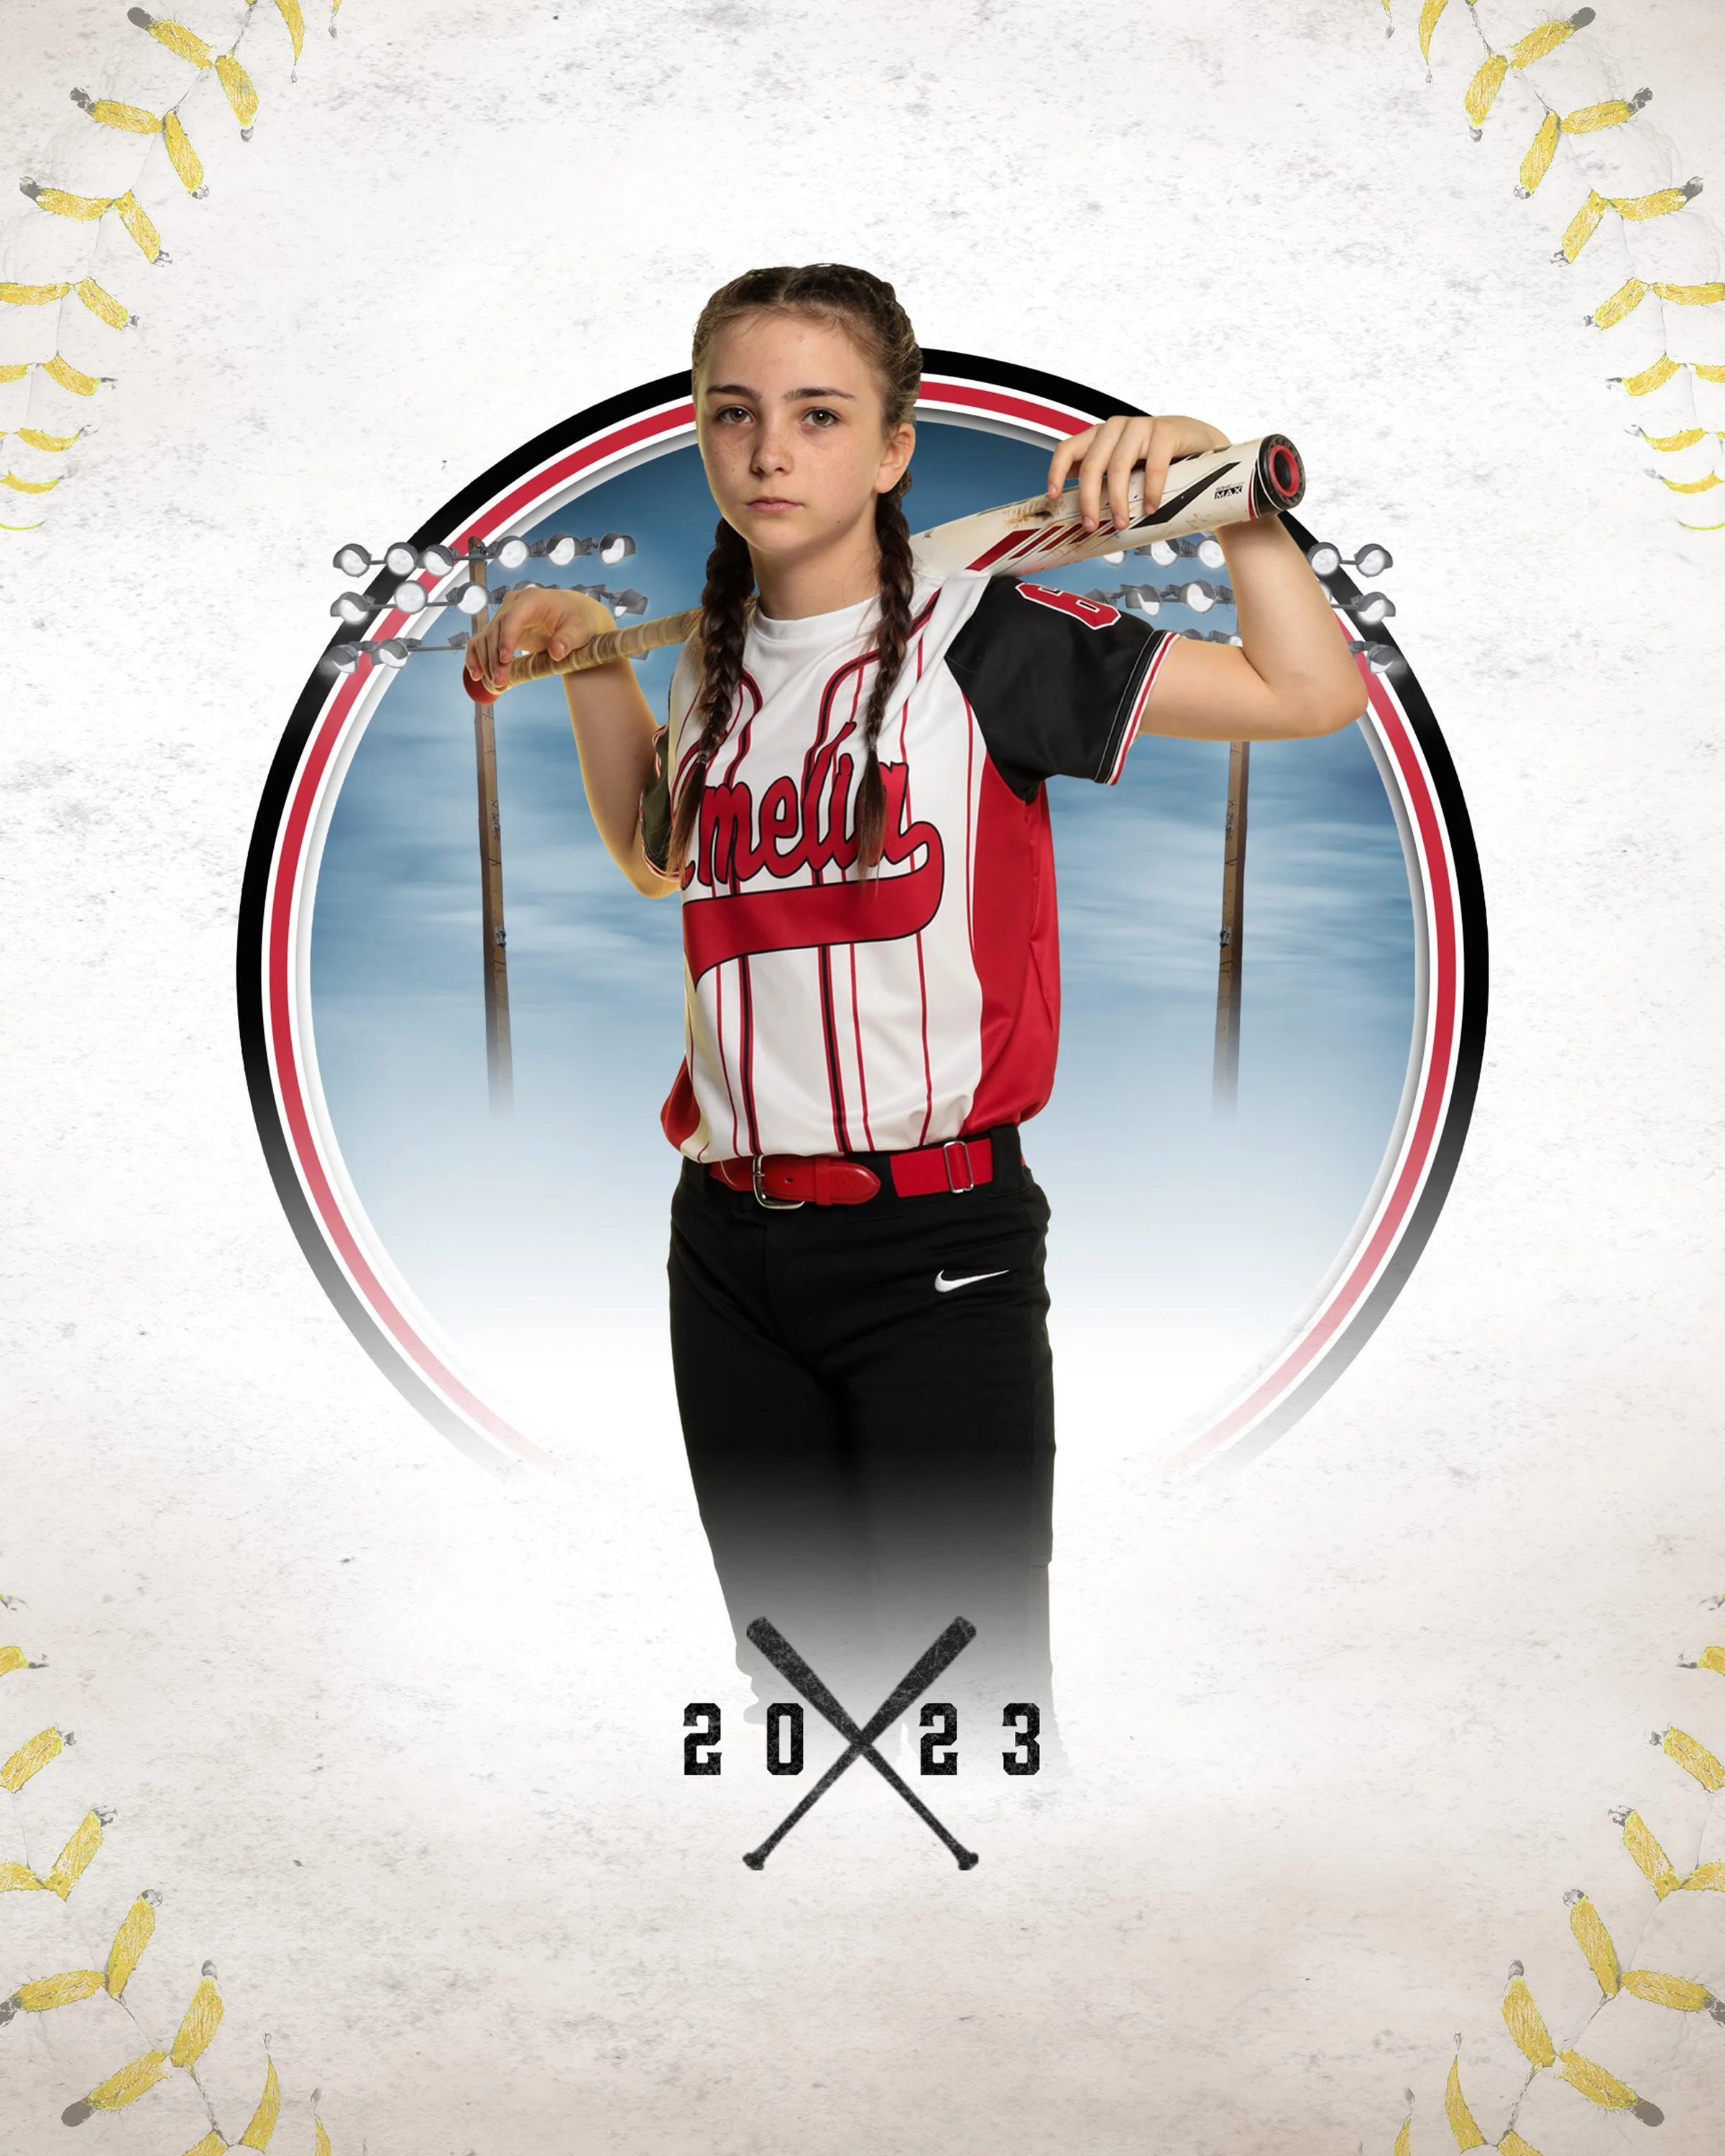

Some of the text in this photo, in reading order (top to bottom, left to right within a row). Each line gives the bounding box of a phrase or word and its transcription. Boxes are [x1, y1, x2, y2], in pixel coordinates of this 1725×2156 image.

[1215, 486, 1242, 499] MAX
[1015, 582, 1121, 630] 6
[681, 722, 927, 890] melia
